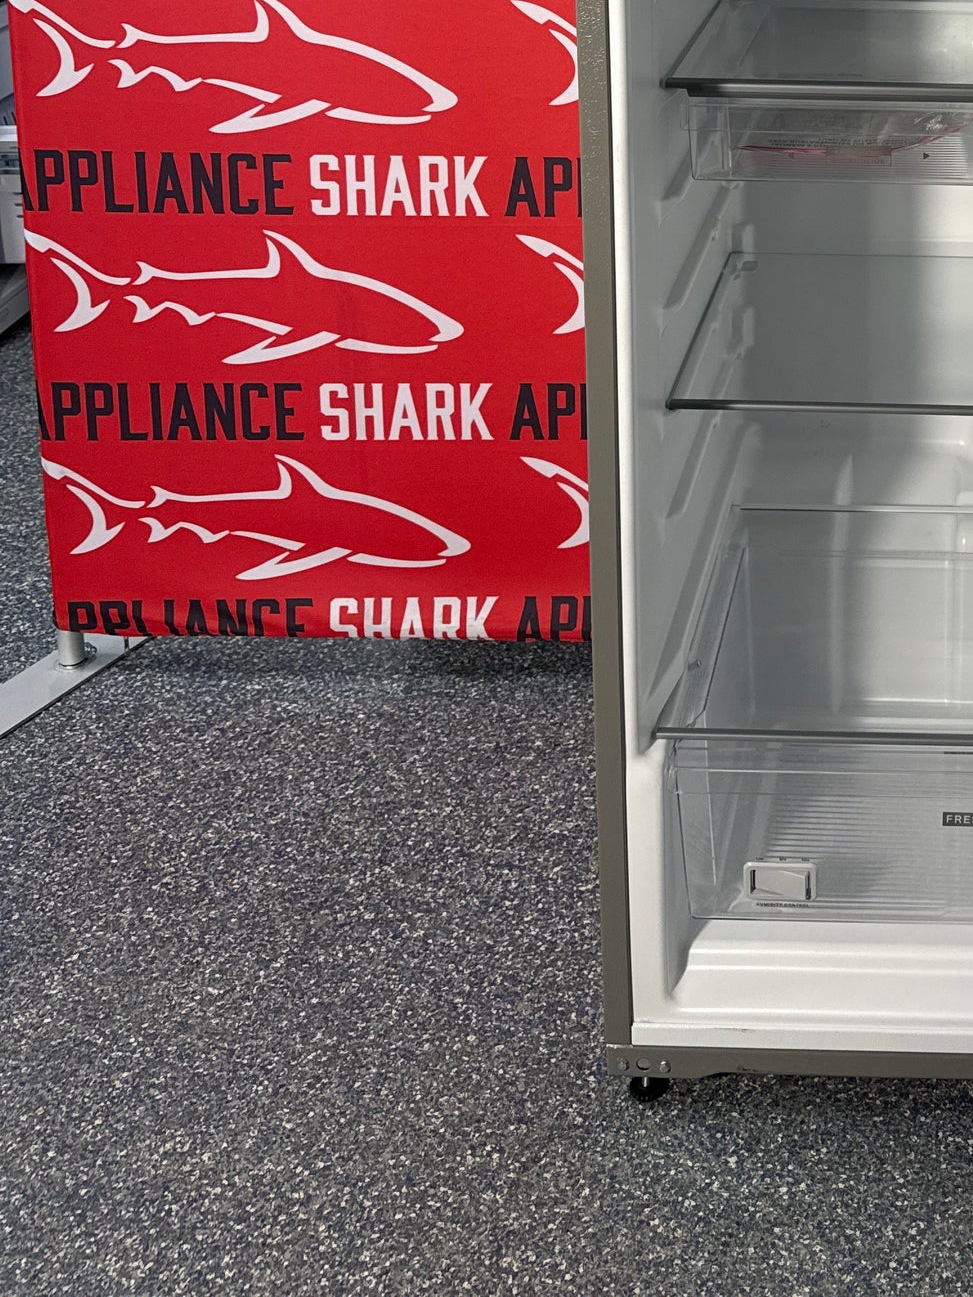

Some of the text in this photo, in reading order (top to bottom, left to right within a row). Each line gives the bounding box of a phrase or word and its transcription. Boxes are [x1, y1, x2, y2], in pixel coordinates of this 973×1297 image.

[310, 154, 488, 217] SHARK
[505, 157, 580, 217] AP
[319, 382, 494, 441] SHARK
[510, 383, 586, 441] AP
[329, 596, 499, 640] SHARK
[517, 596, 591, 642] AP
